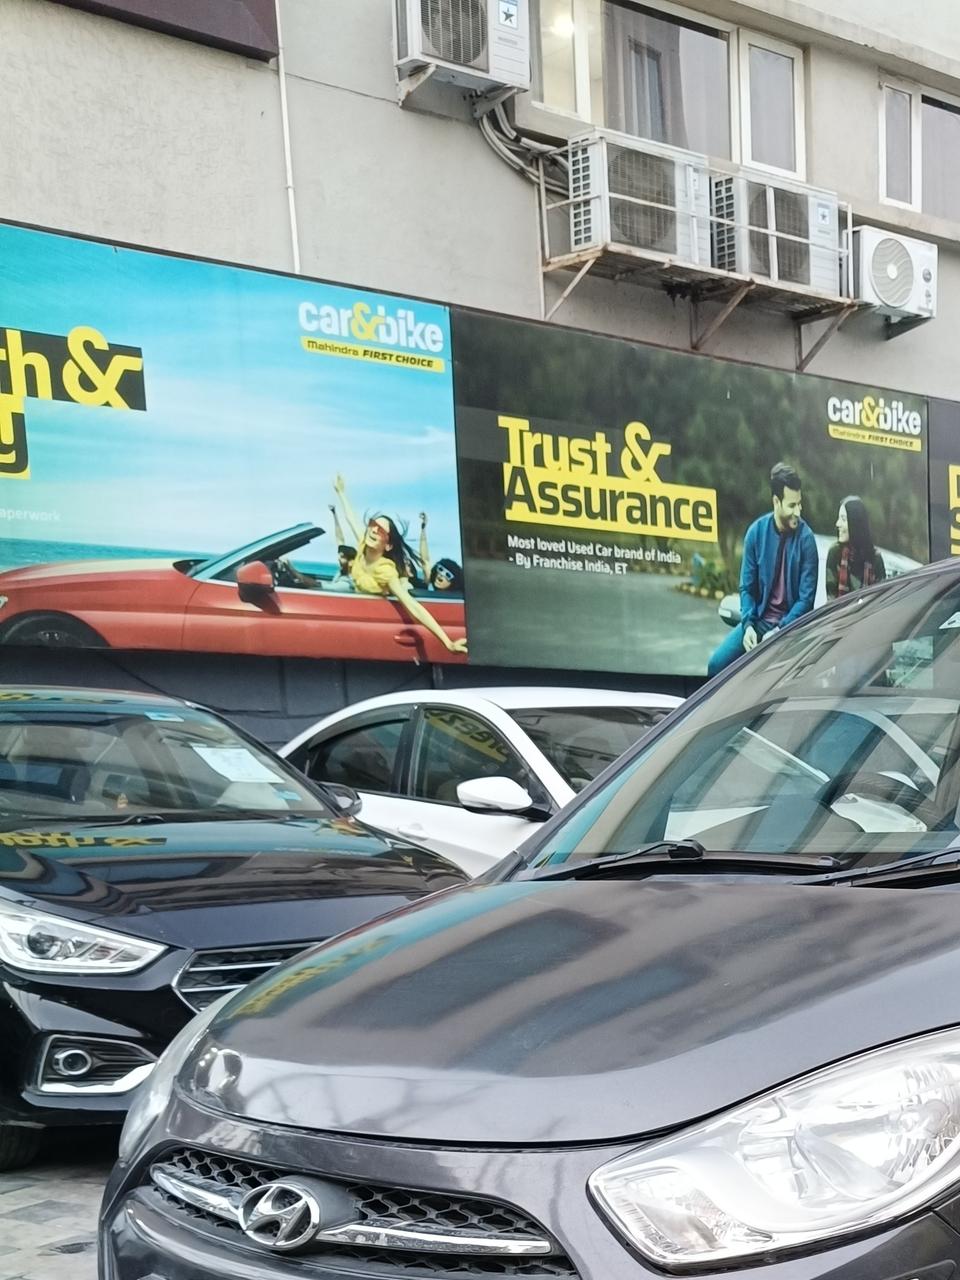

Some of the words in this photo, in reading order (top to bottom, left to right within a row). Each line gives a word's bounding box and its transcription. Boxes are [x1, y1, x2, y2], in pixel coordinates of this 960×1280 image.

[298, 300, 444, 353] car&bike
[62, 325, 144, 410] &
[307, 340, 359, 356] Mahindra
[363, 349, 394, 362] FIRST
[395, 355, 433, 368] CHOICE
[827, 396, 921, 435] car&bike
[498, 415, 612, 477] Trust
[620, 421, 672, 484] &
[868, 434, 888, 443] FIRST
[889, 438, 914, 448] CHOICE
[505, 465, 713, 533] Assurance
[507, 534, 535, 549] Most
[537, 537, 566, 553] loved
[567, 541, 594, 556] Used
[595, 544, 613, 558] Car
[614, 545, 643, 560] brand
[644, 549, 656, 561] of
[656, 550, 682, 564] India
[515, 553, 531, 569] By
[533, 555, 583, 572] Franchise
[585, 560, 613, 576] India,
[614, 562, 628, 575] ET
